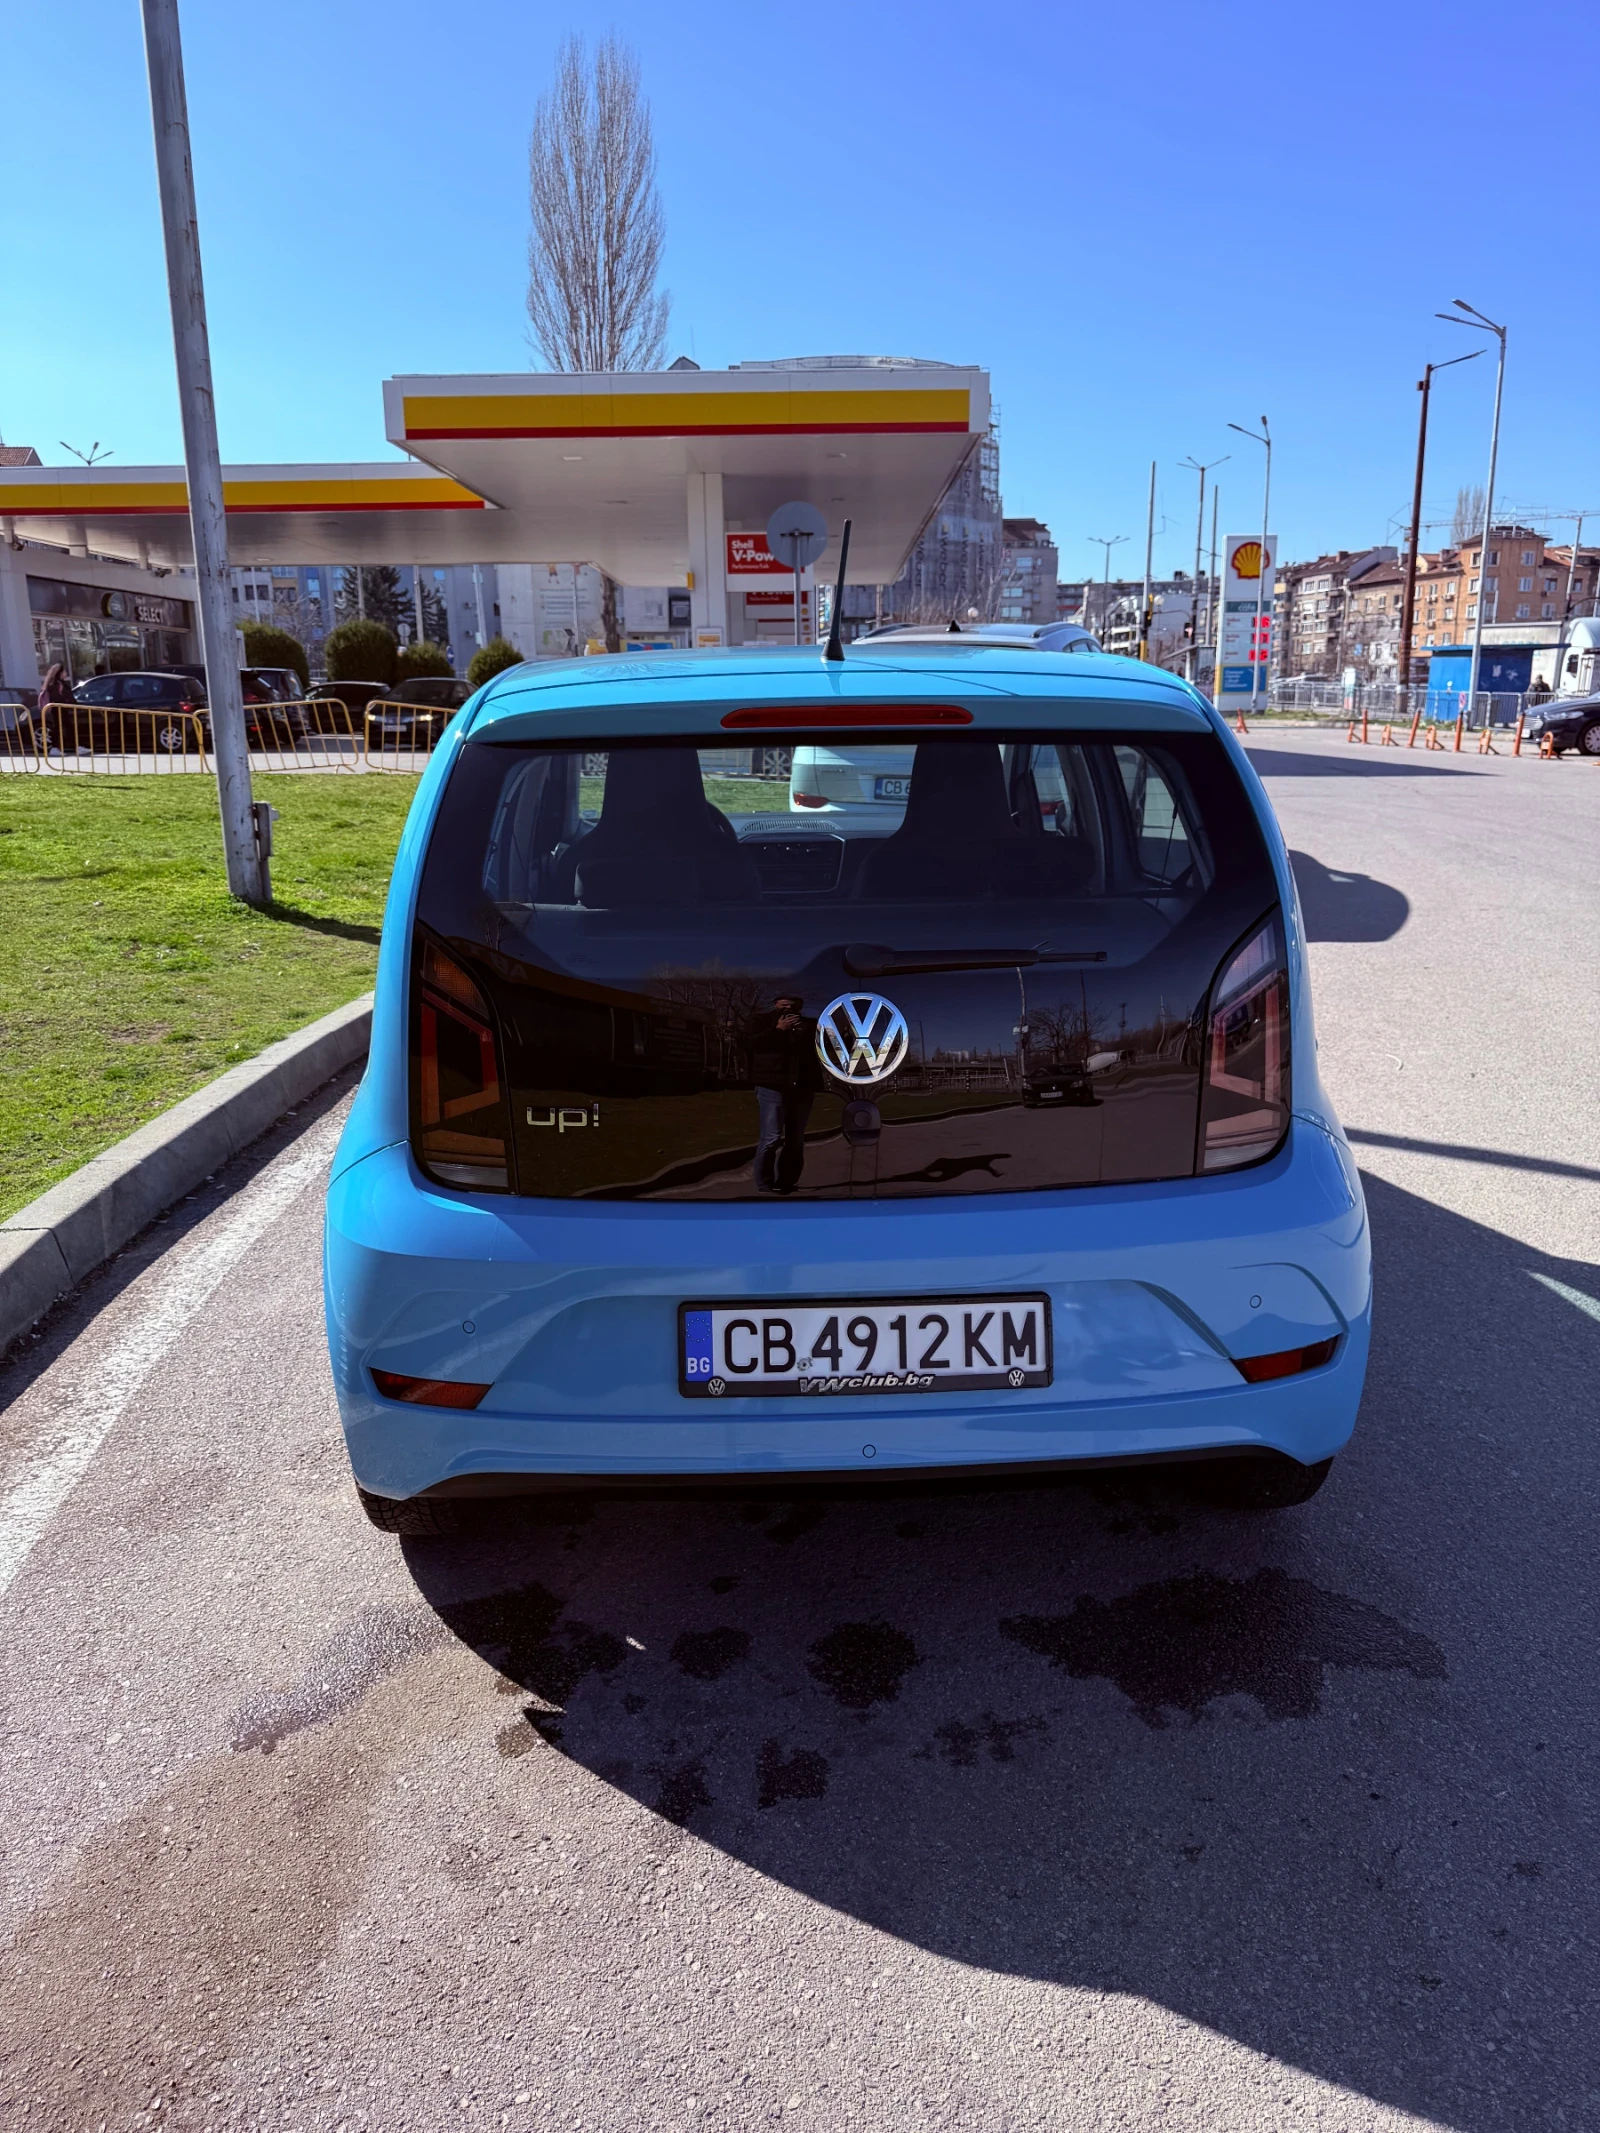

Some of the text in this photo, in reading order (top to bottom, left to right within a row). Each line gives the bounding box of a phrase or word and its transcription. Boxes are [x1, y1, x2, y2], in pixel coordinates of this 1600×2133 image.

[731, 539, 754, 549] Shell
[732, 550, 775, 562] V-Pow
[138, 606, 164, 623] SELECT
[884, 780, 902, 794] CB
[526, 1103, 600, 1133] up!
[724, 1311, 1037, 1374] CB 4912 KM
[687, 1357, 710, 1374] BG
